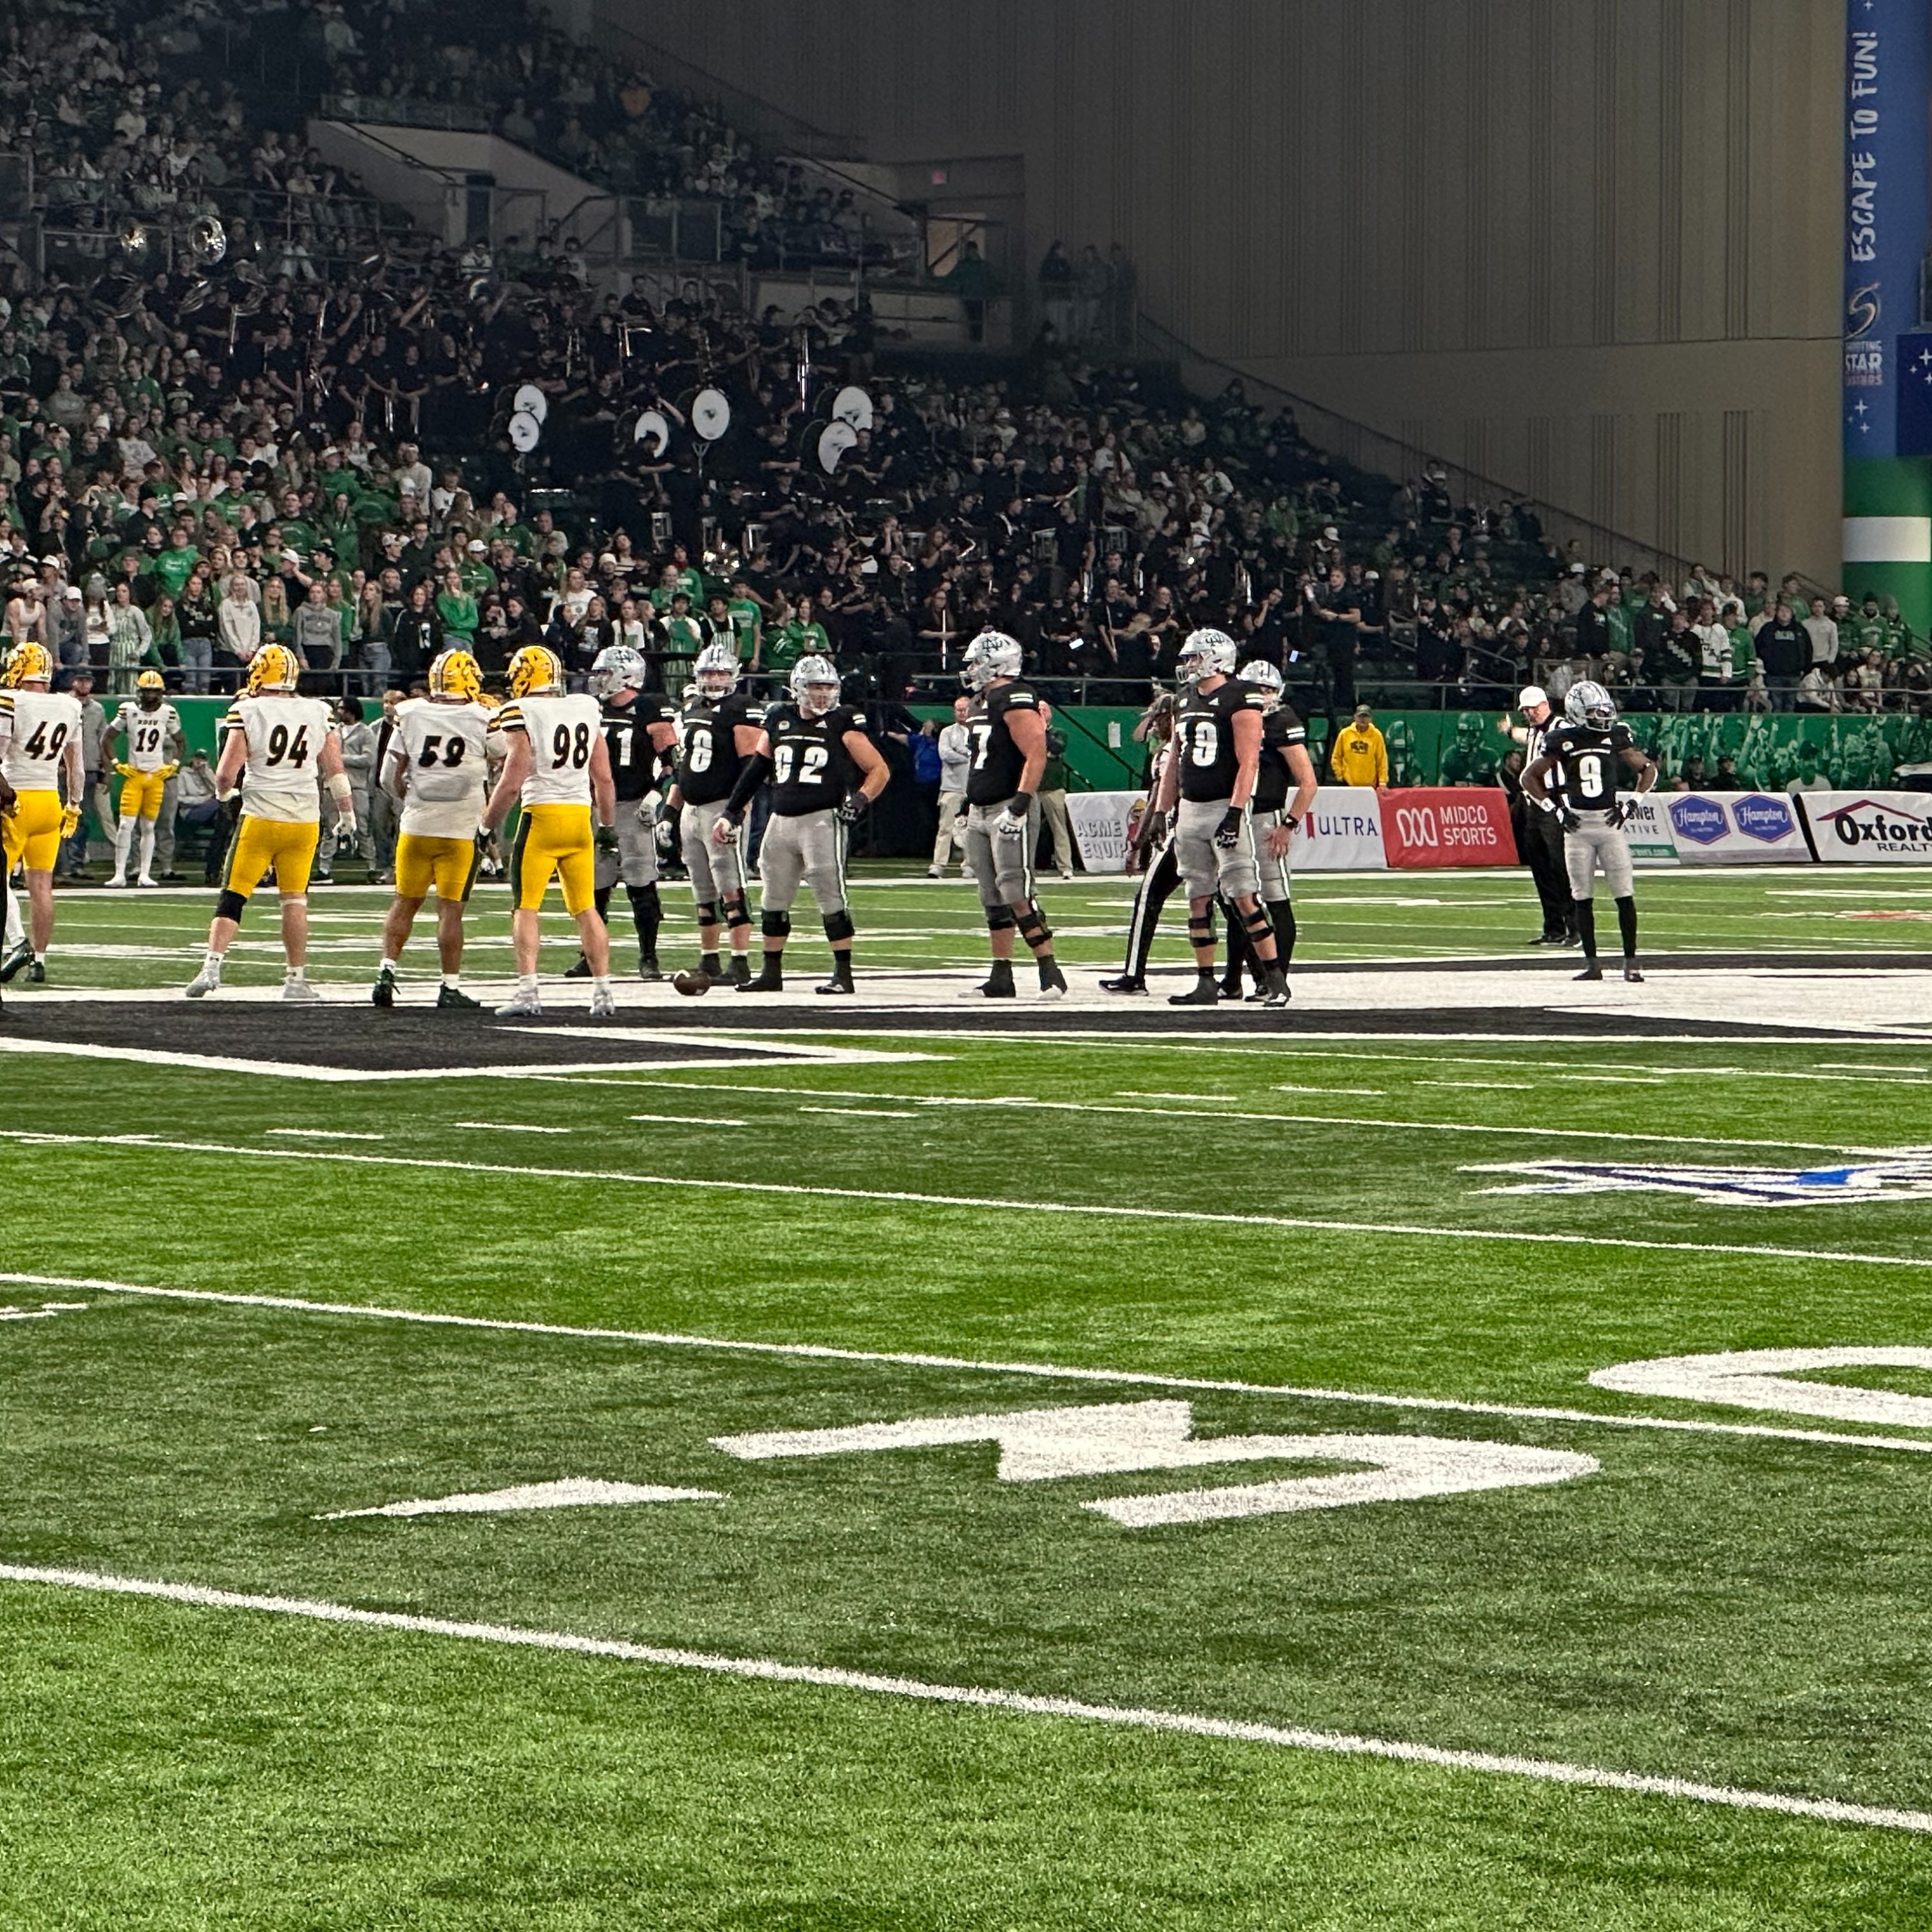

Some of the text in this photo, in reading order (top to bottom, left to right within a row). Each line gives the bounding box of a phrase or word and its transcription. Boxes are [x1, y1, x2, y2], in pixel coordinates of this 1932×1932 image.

[1850, 32, 1879, 262] ESCAPE TO FUN!
[24, 721, 67, 760] 49
[136, 728, 160, 752] 19
[265, 724, 308, 769] 94
[419, 735, 465, 768] 59
[552, 723, 589, 770] 98
[1579, 755, 1604, 799] 9
[1075, 819, 1122, 837] ACME
[1318, 816, 1378, 837] ULTRA
[1439, 805, 1488, 825] MIDCO
[1674, 807, 1723, 828] Hampton
[1738, 806, 1788, 827] Hampton
[1835, 812, 1932, 846] Oxford
[1443, 826, 1498, 846] SPORTS
